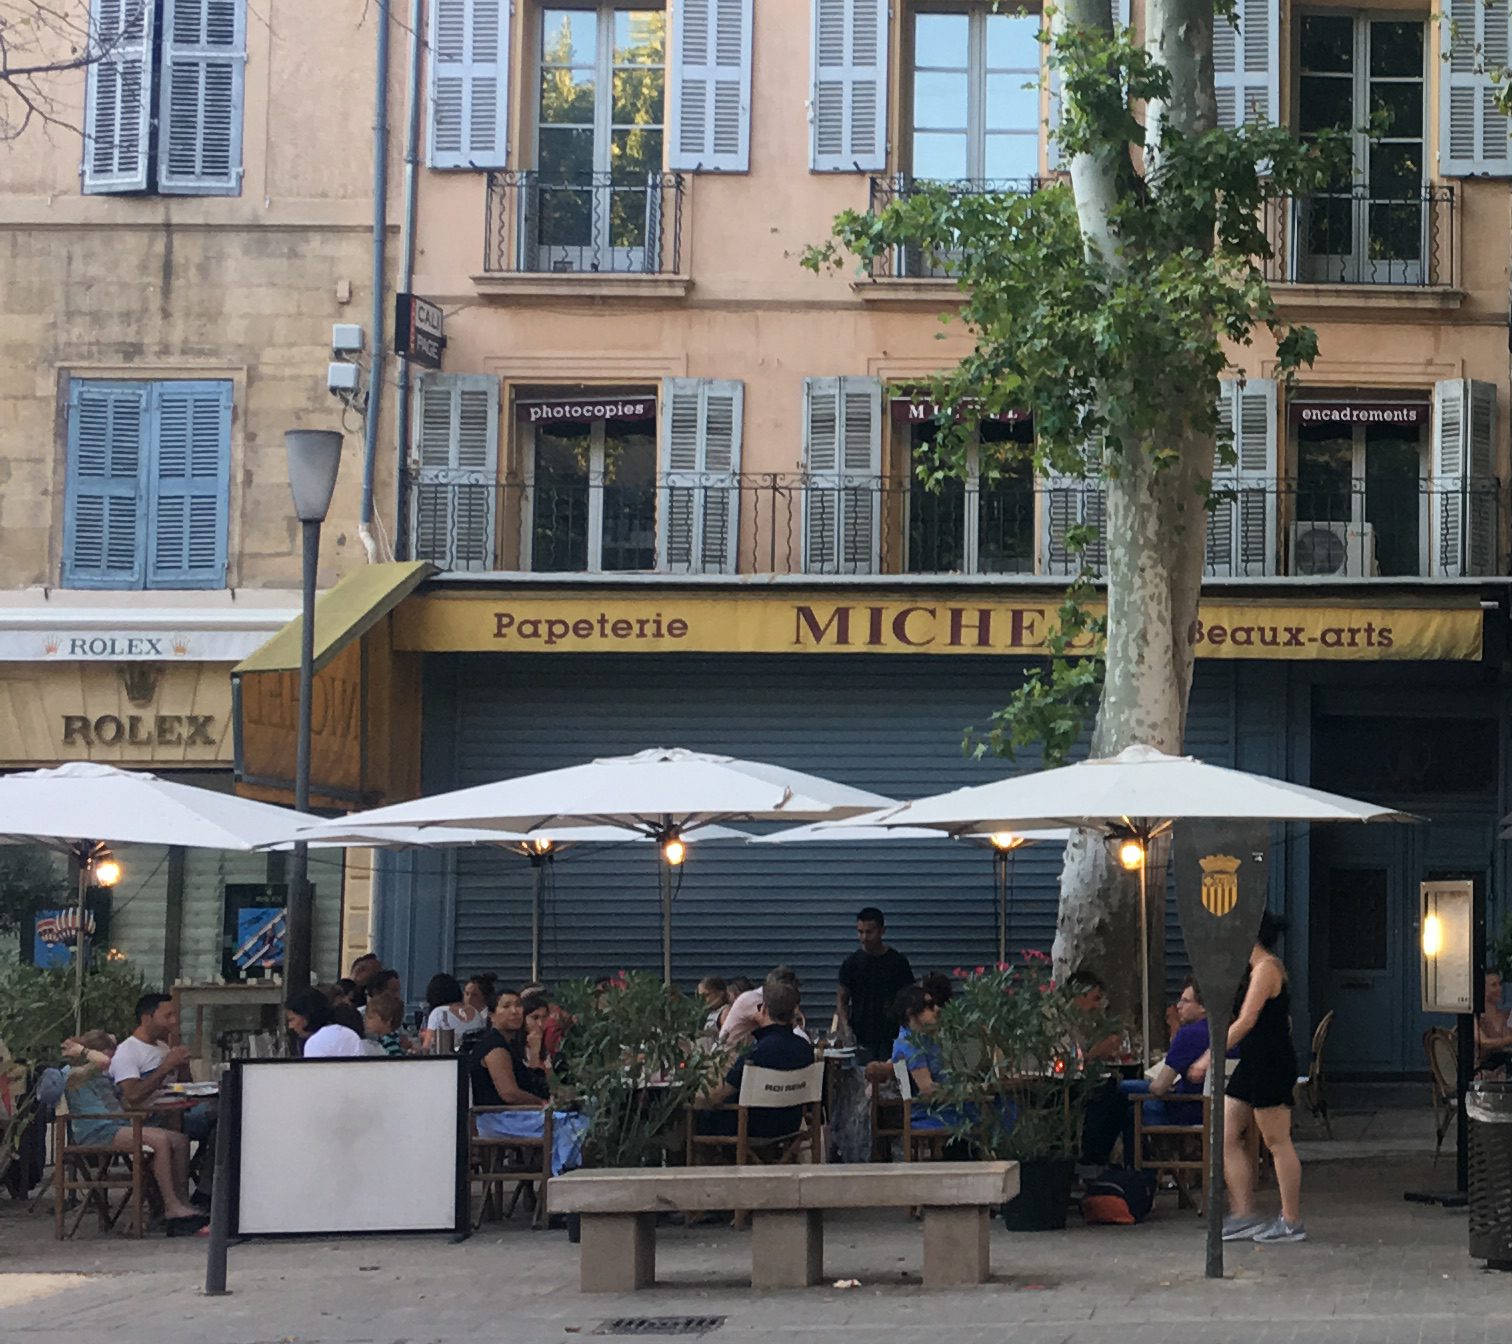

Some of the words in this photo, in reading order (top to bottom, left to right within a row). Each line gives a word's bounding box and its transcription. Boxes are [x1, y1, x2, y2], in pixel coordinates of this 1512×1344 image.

[416, 334, 439, 359] PAGE
[528, 400, 645, 423] photocopies
[1301, 406, 1418, 422] encadrements
[493, 612, 689, 645] Papeterie
[69, 637, 164, 656] ROLEX
[62, 714, 217, 747] ROLEX
